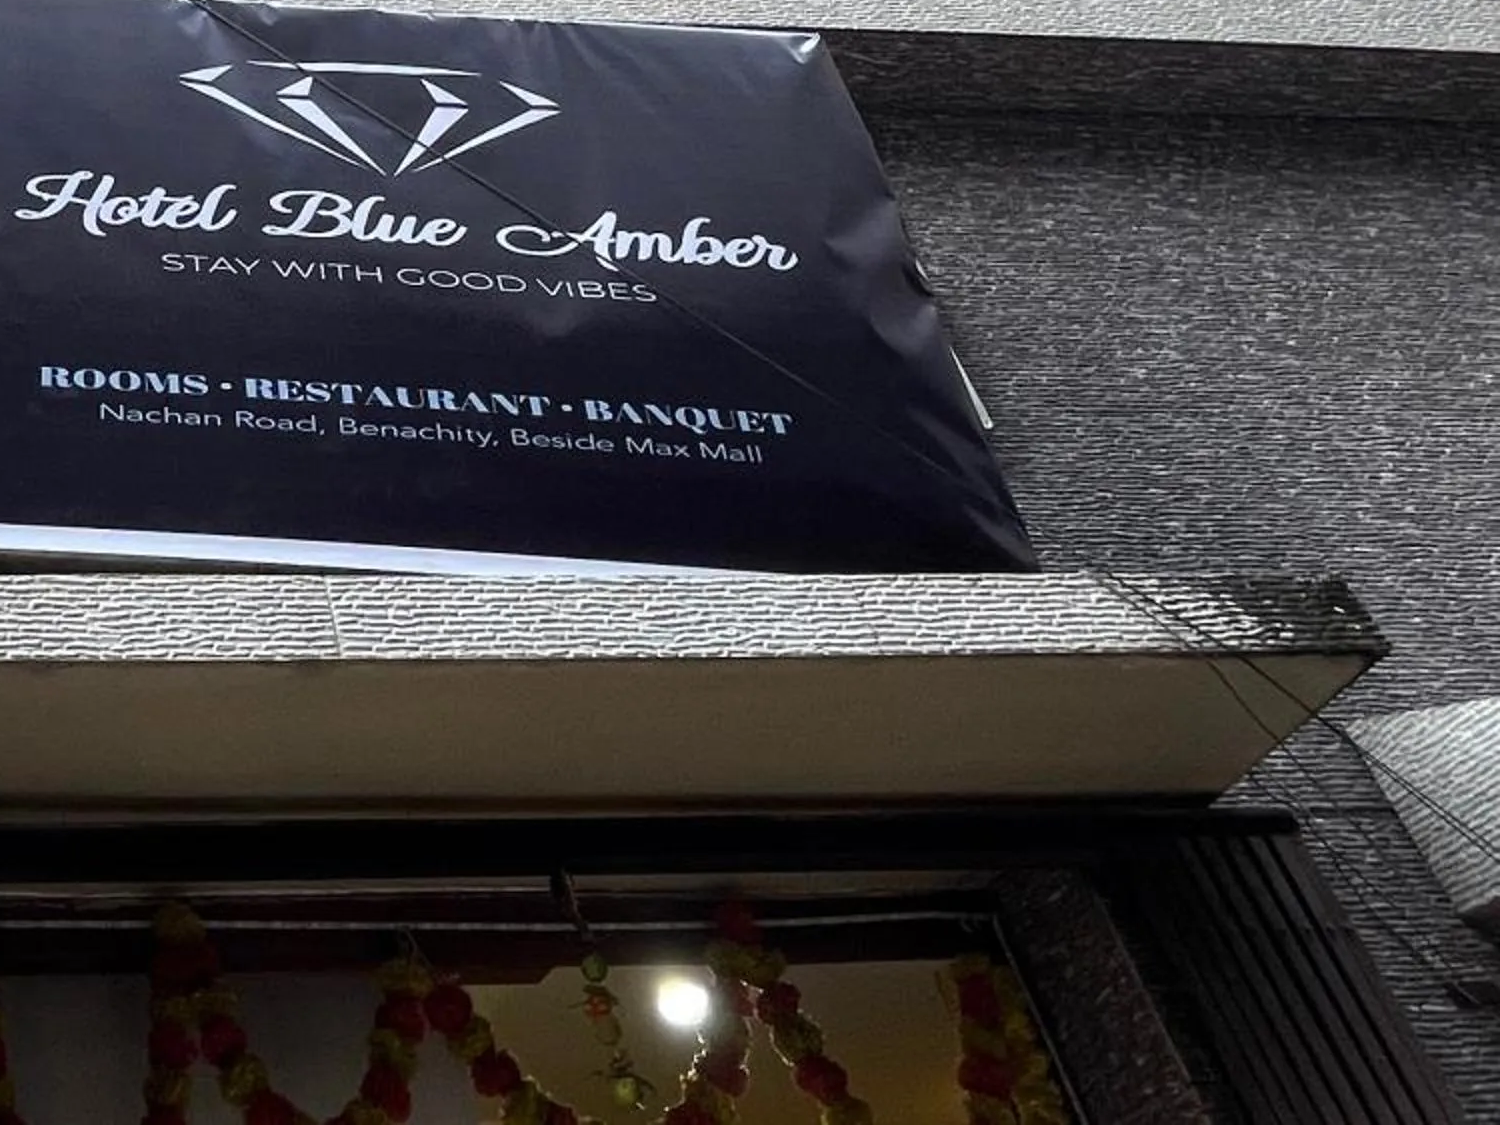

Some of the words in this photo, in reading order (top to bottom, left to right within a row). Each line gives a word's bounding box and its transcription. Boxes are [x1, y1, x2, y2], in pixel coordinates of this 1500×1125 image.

[14, 170, 238, 237] Hotel
[261, 190, 468, 246] Blue
[495, 210, 799, 272] Amber
[160, 252, 260, 276] STAY
[271, 259, 384, 284] WITH
[396, 267, 528, 293] GOOD
[535, 277, 658, 303] VIBES
[40, 365, 209, 395] ROOMS
[245, 377, 551, 416] RESTAURANT
[583, 398, 794, 435] BANQUET
[99, 402, 222, 428] Nachan
[235, 409, 326, 436] Road,
[339, 416, 500, 448] Benachity,
[509, 427, 616, 454] Beside
[624, 435, 691, 459] Max
[700, 441, 764, 464] Mall
